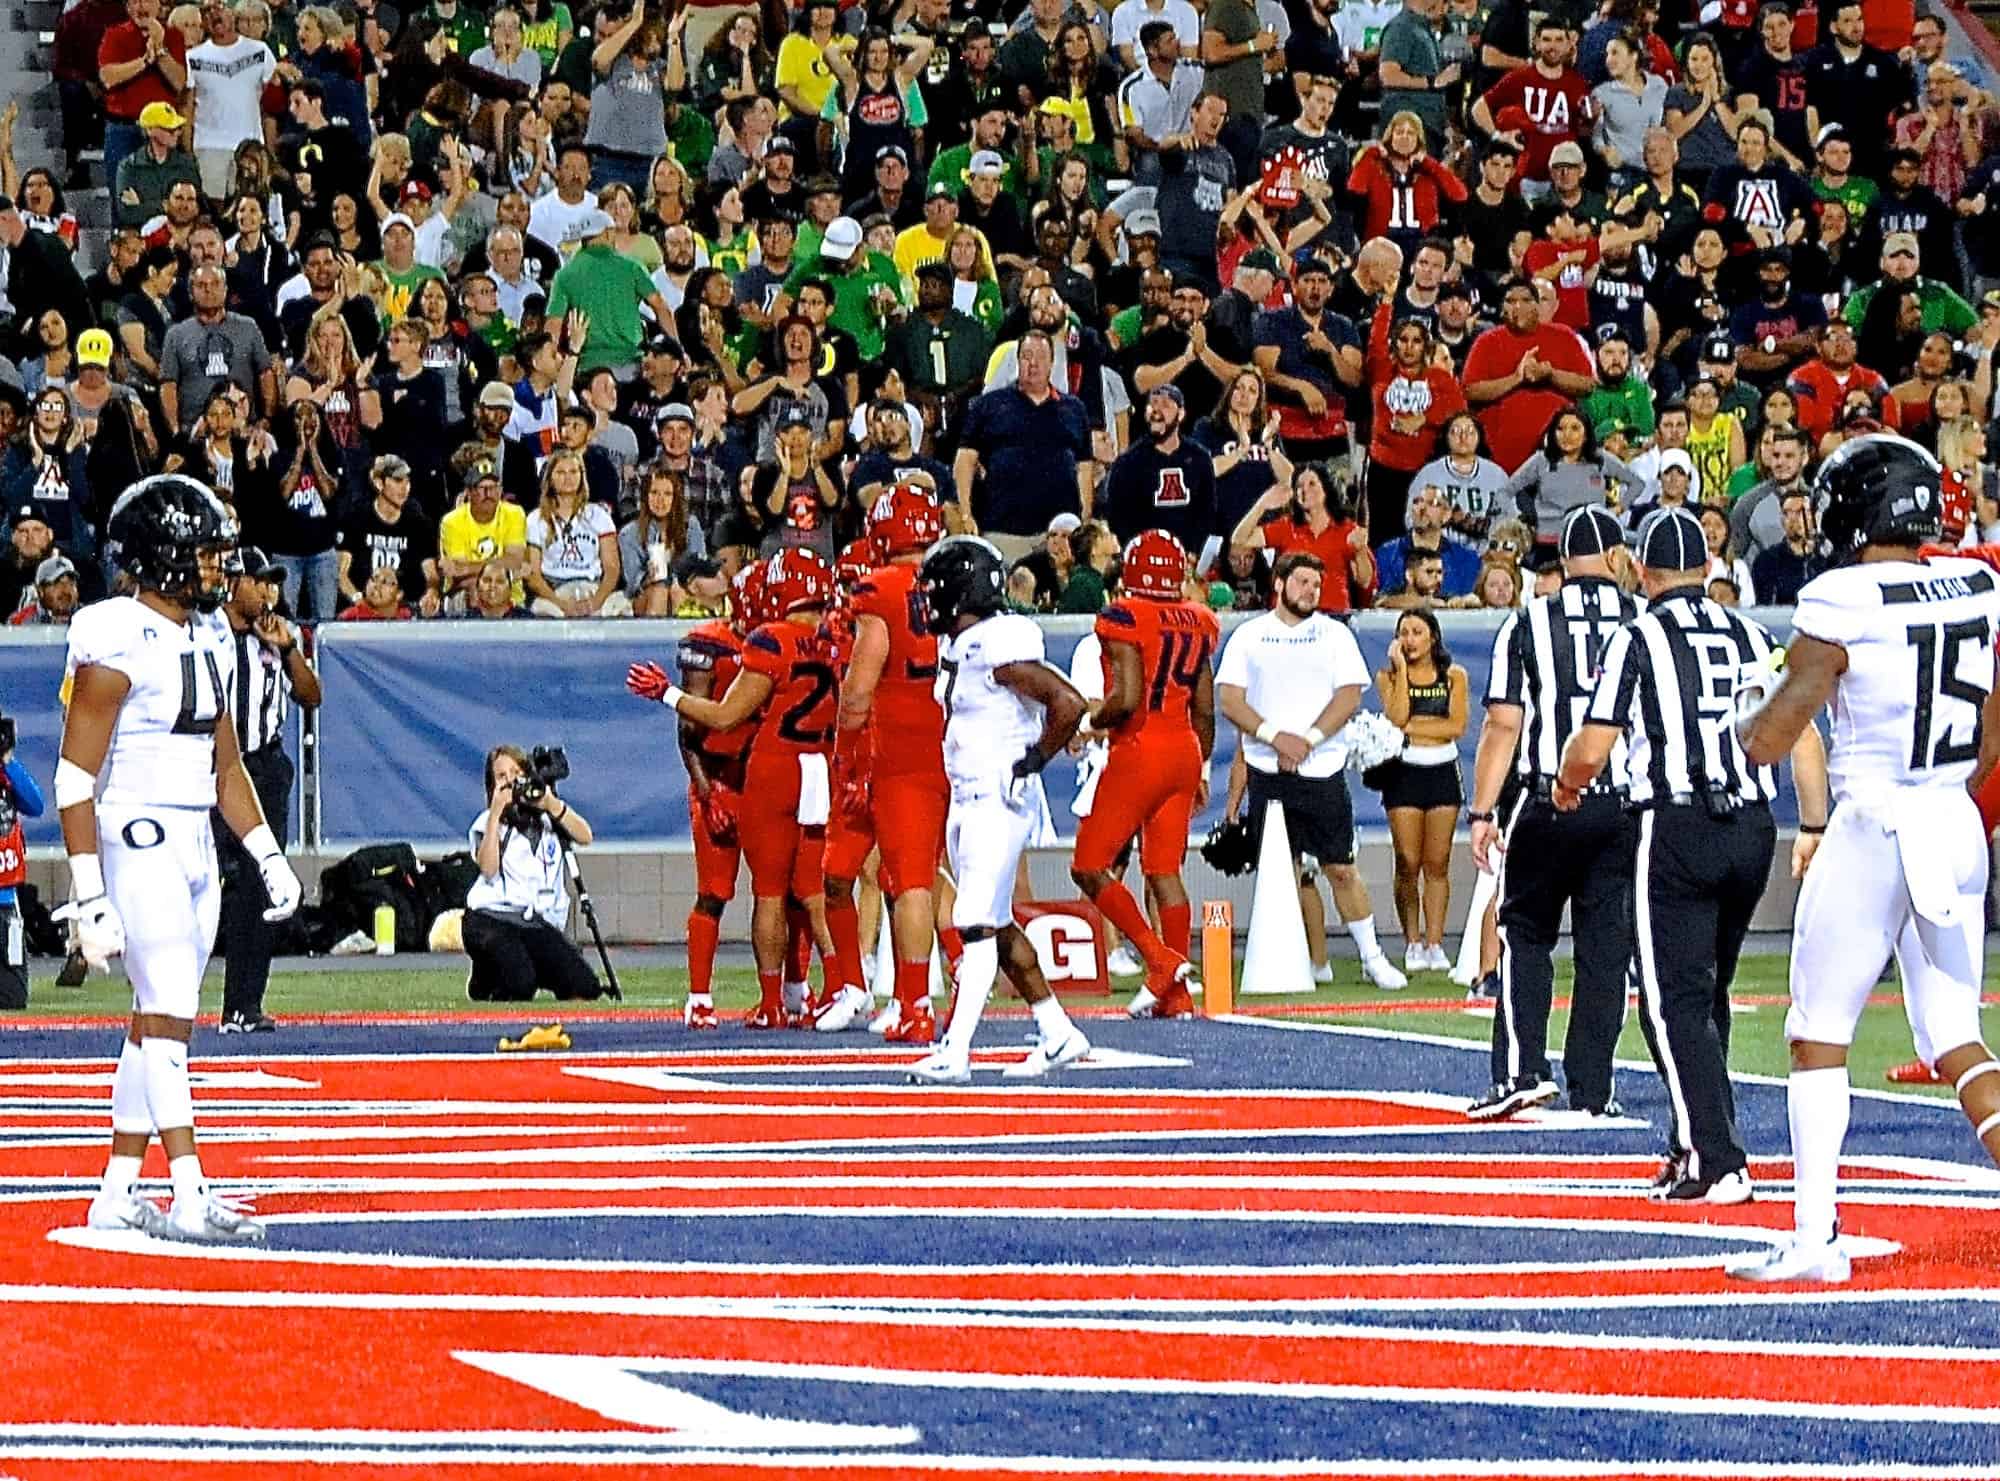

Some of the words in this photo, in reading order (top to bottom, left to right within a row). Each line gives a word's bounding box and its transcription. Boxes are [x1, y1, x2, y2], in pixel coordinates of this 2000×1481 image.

[1523, 85, 1570, 126] UA
[1773, 73, 1806, 111] 15
[1733, 178, 1784, 245] A
[928, 340, 947, 386] 1
[1154, 467, 1191, 507] A
[1149, 629, 1209, 712] 14
[1906, 615, 1991, 772] 15
[121, 817, 166, 850] O
[1023, 914, 1097, 981] G
